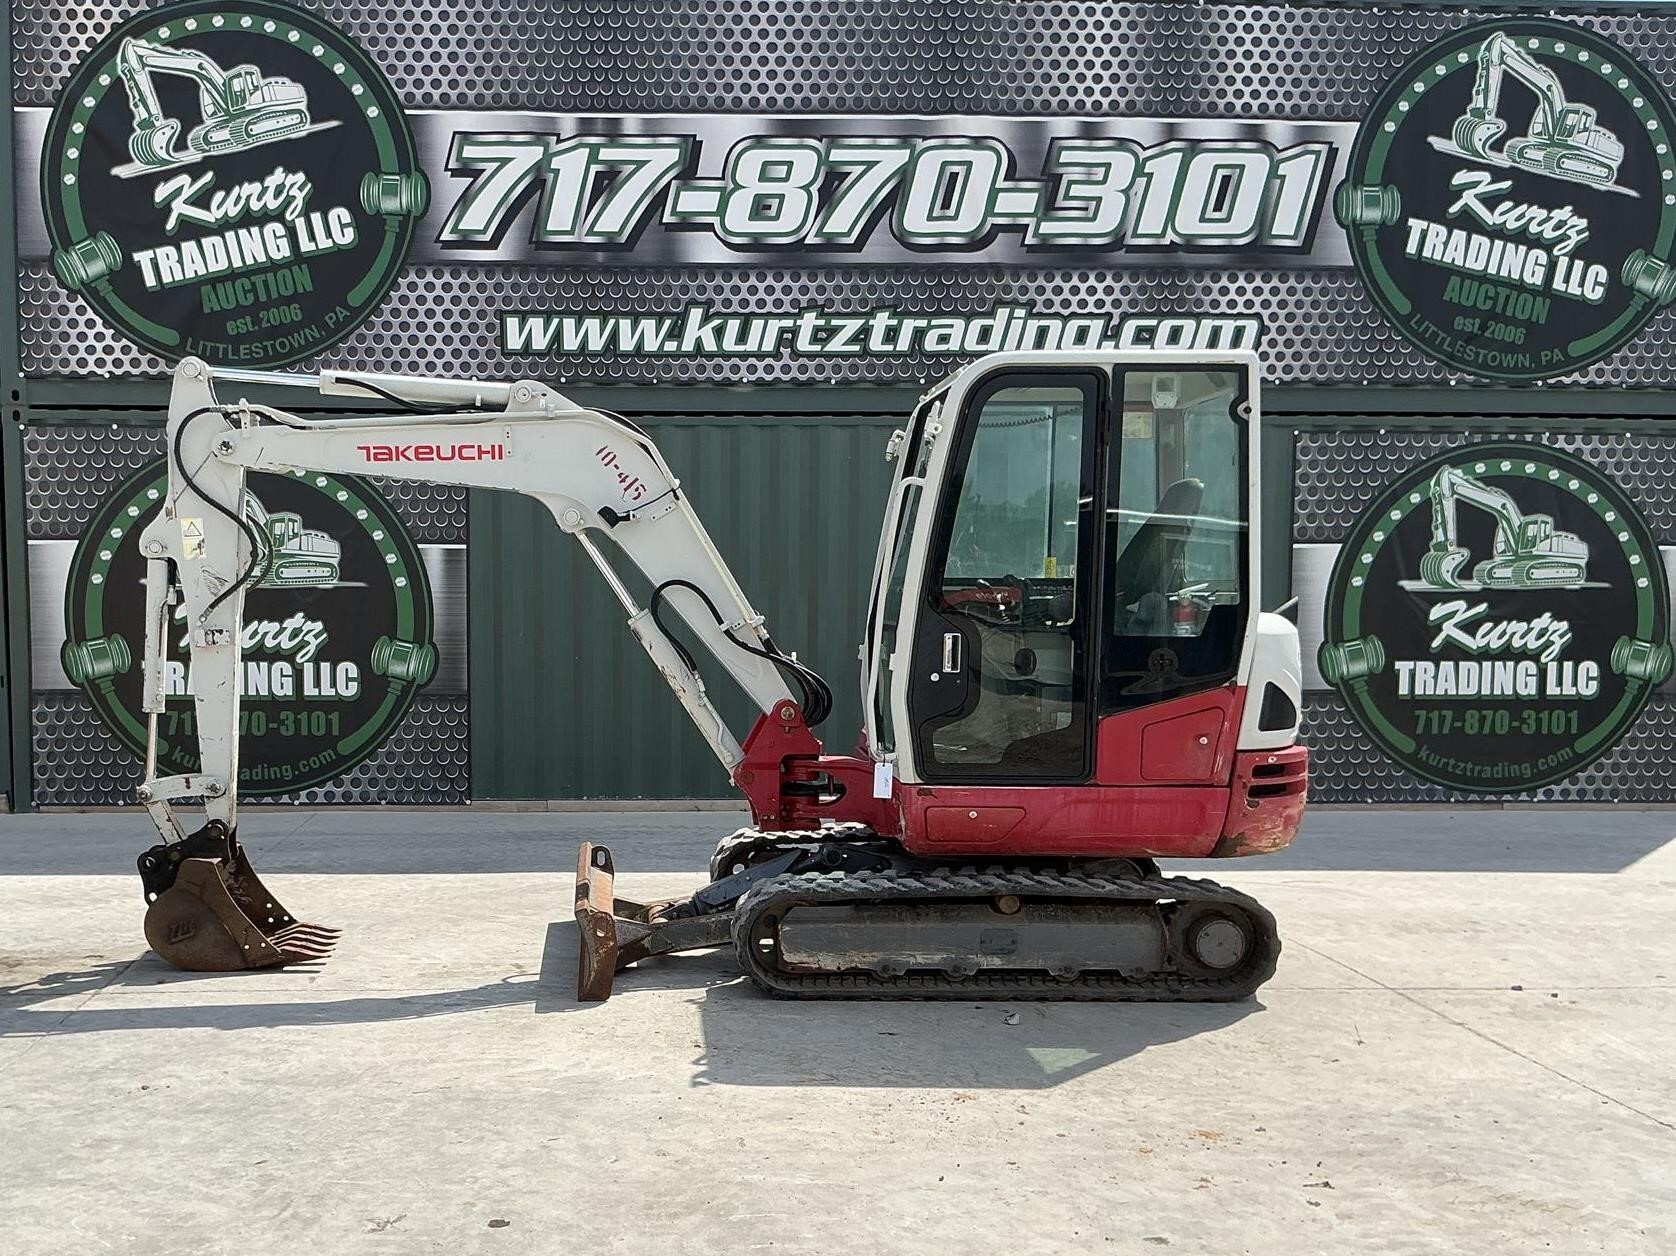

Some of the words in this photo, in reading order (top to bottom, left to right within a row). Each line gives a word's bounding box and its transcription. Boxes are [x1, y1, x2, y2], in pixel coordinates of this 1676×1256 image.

[154, 166, 312, 231] Kurtz
[440, 133, 1336, 250] 717-870-3101
[1448, 169, 1589, 256] Kurtz
[132, 221, 292, 289] TRADING
[294, 206, 357, 255] LLC
[1405, 217, 1549, 289] TRADING
[1551, 255, 1610, 303] LLC
[200, 263, 314, 314] AUCTION
[1442, 275, 1551, 324] AUCTION
[185, 324, 326, 360] LITTLESTOWN,
[324, 305, 351, 329] PA
[225, 315, 258, 336] est.
[259, 303, 303, 329] 2006
[502, 302, 1262, 353] www.kurtztrading.com
[1409, 313, 1536, 369] LITTLESTOWN,
[1540, 348, 1565, 366] PA
[1485, 320, 1527, 345] 2006
[357, 444, 503, 463] TAKEUCHI
[595, 446, 647, 501] 10-415
[174, 603, 328, 664] rtz
[1430, 600, 1573, 663] Kurtz
[303, 661, 361, 697] LLC
[1395, 661, 1537, 698] TRADING
[1547, 661, 1600, 698] LLC
[167, 710, 341, 738] 7170-3101
[1415, 709, 1580, 736] 717-870-3101
[172, 746, 337, 781] kuading.com
[1417, 745, 1575, 779] kurtztrading.com
